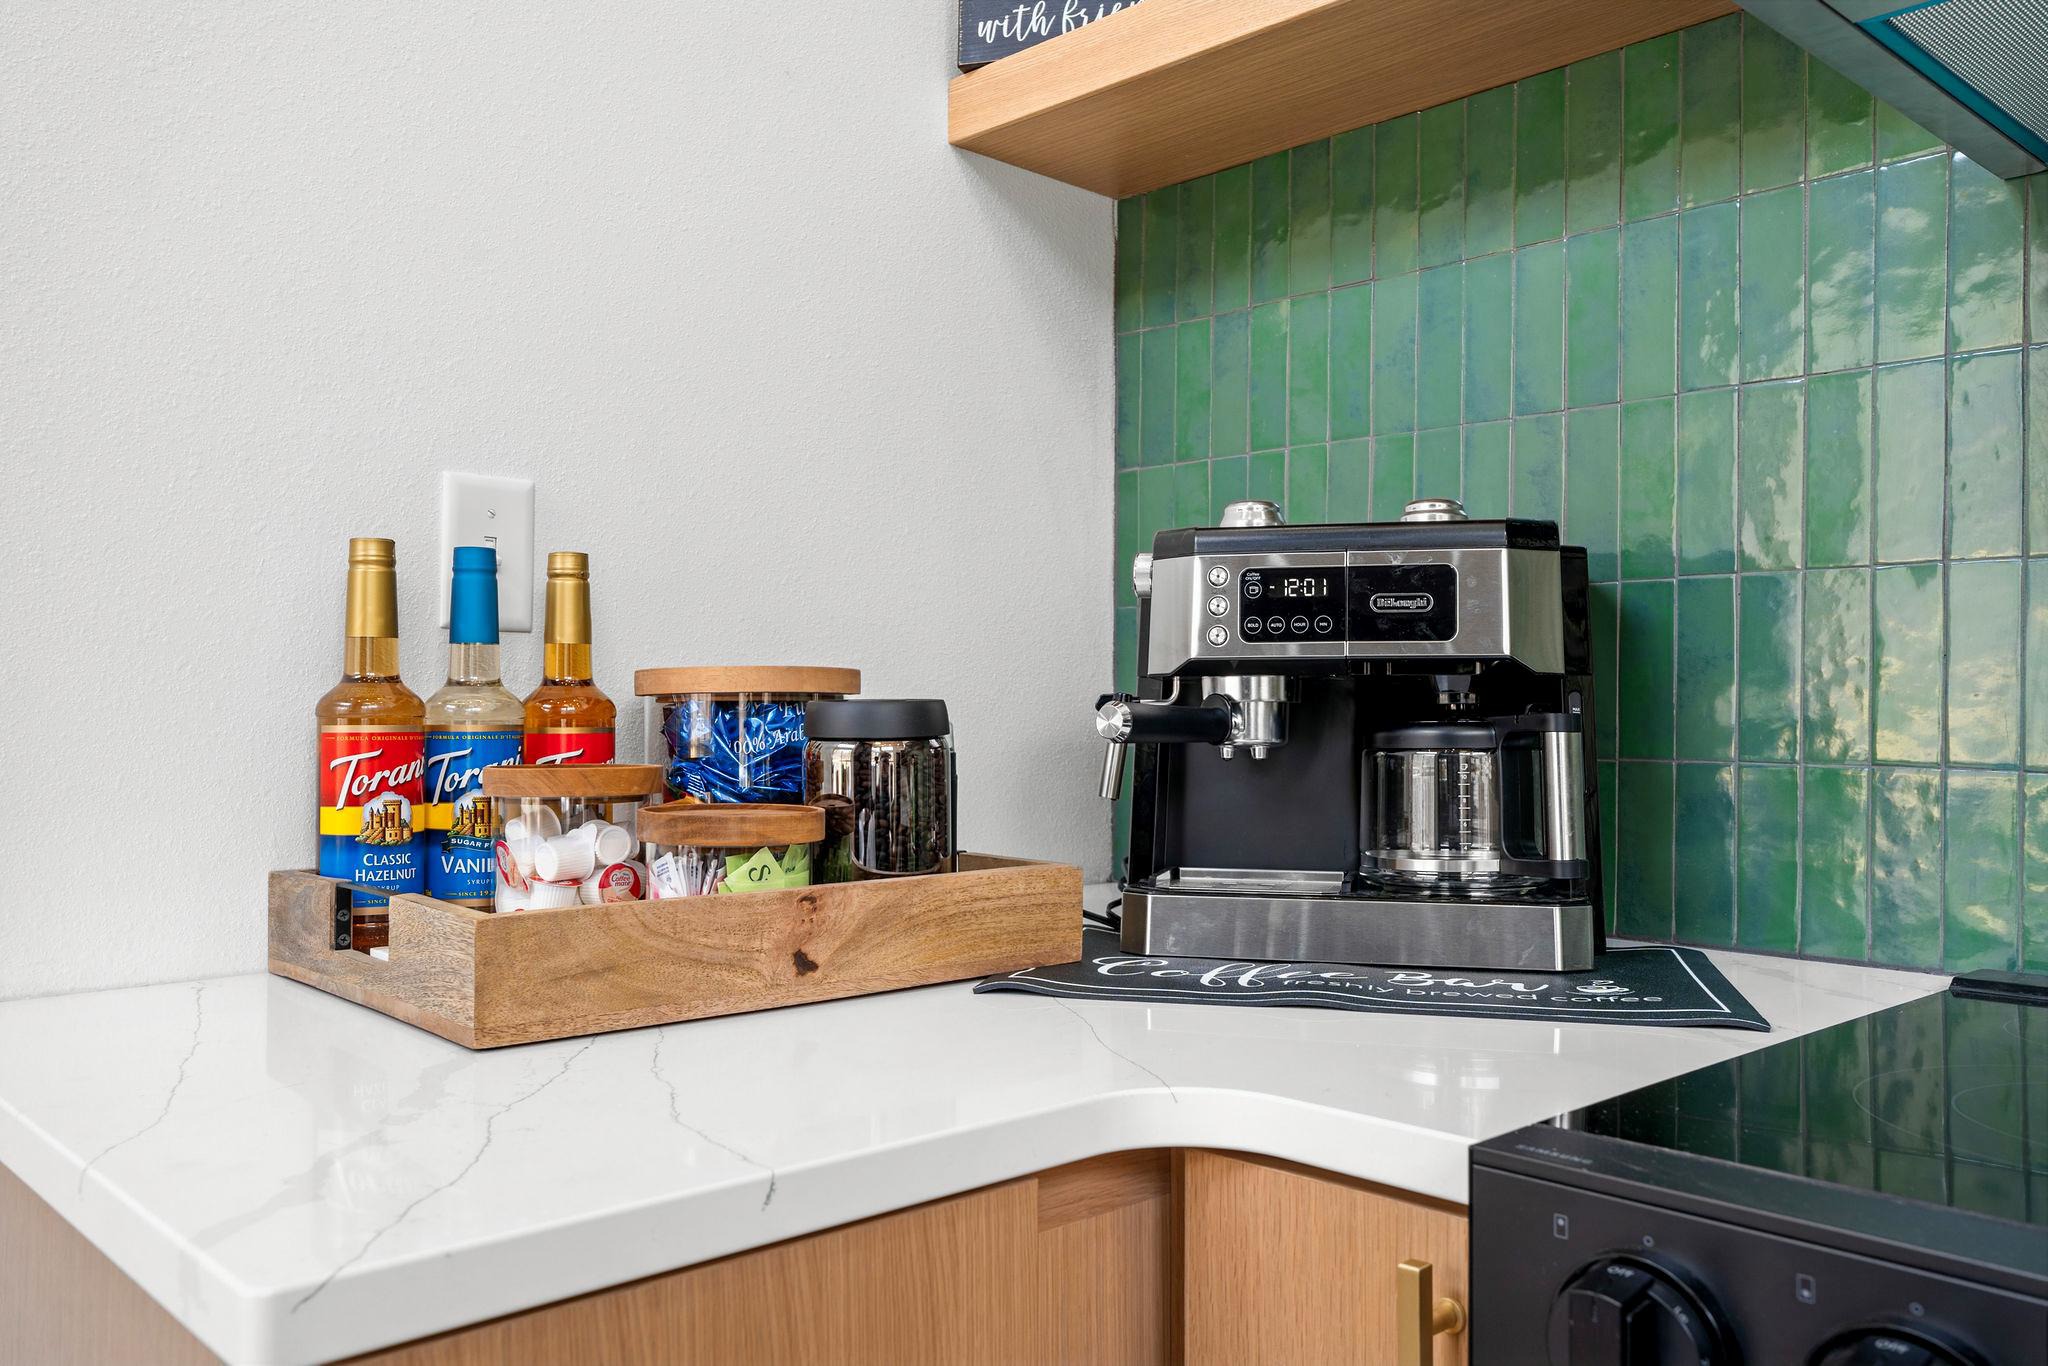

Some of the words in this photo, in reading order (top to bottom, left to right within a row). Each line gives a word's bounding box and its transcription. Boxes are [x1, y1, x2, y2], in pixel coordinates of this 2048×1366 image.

[978, 0, 1055, 43] with
[1062, 0, 1144, 34] frie
[1284, 578, 1327, 597] 12:01
[329, 747, 425, 811] Torani
[427, 745, 522, 806] Tori
[450, 838, 482, 848] SUGAR
[363, 853, 412, 866] CLASSIC
[441, 855, 495, 874] VANIL
[355, 867, 417, 882] HAZELNUT
[611, 873, 631, 882] Coffee
[1092, 956, 1369, 988] Coffee
[1283, 979, 1394, 993] freshly
[1406, 988, 1537, 1001] brewed
